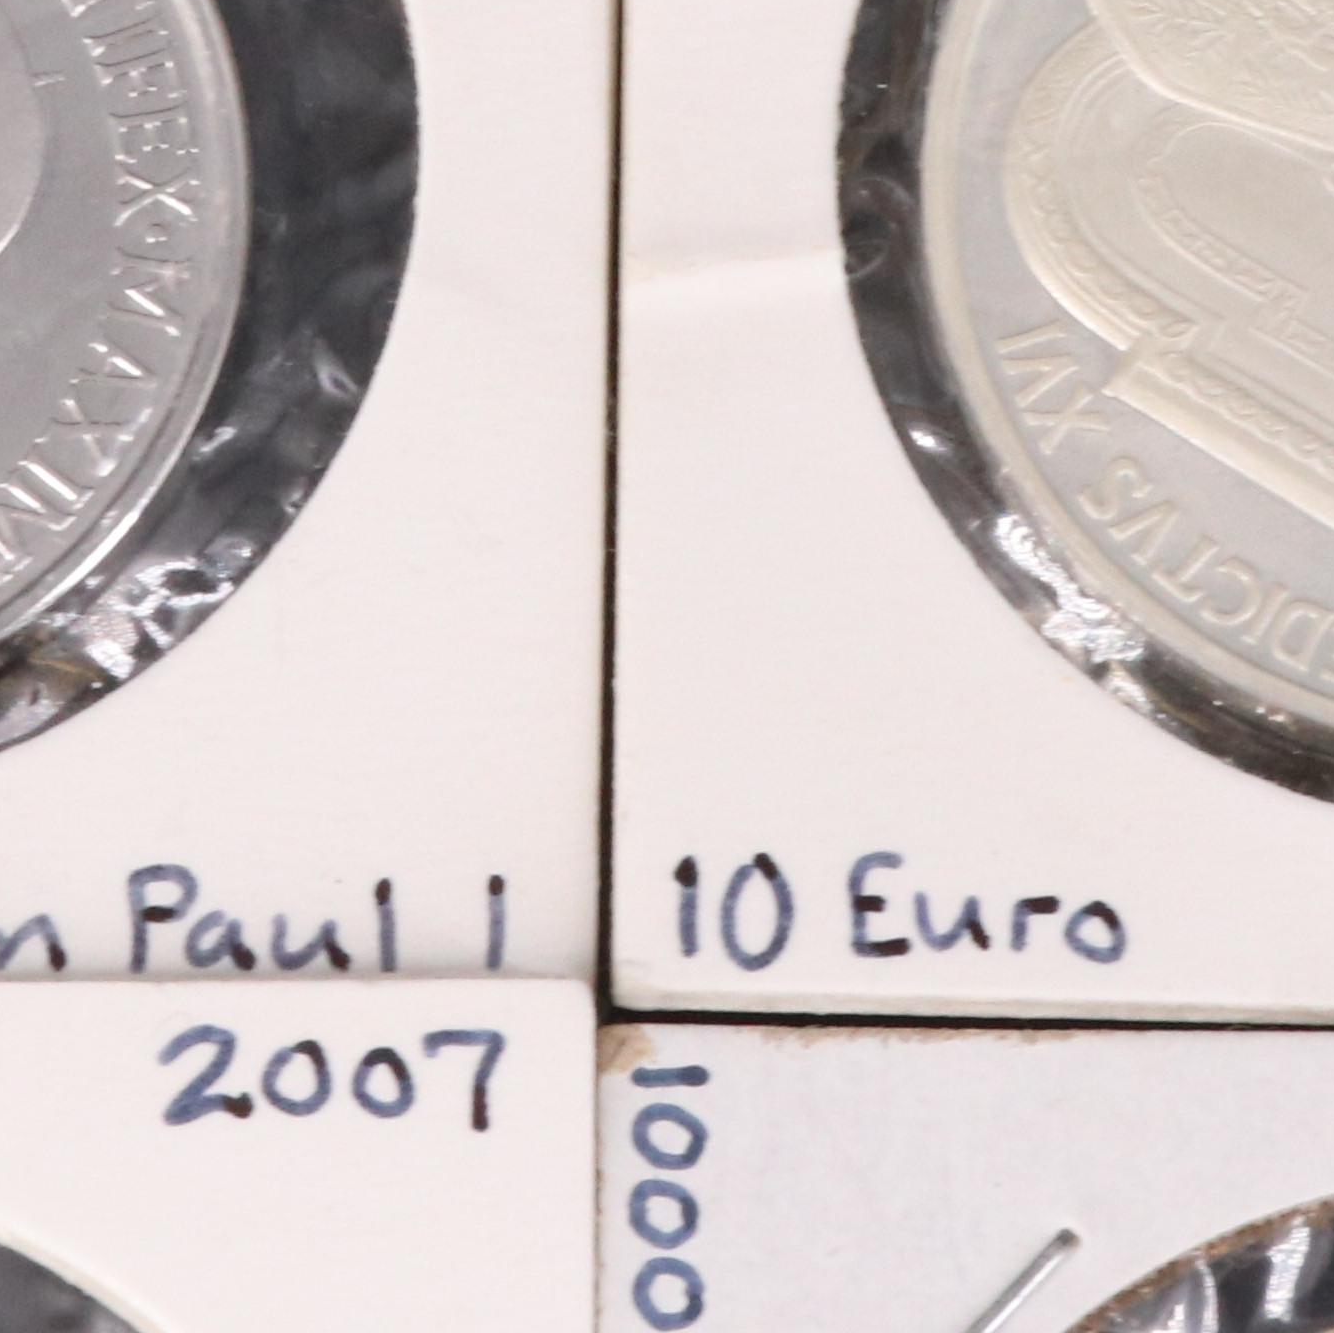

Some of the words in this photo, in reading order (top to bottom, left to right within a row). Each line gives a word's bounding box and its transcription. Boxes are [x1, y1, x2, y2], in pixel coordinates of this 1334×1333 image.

[995, 319, 1113, 457] XVI
[125, 864, 397, 975] Paul
[673, 852, 794, 971] 10
[847, 852, 1126, 964] Euro
[161, 1025, 505, 1132] 2007
